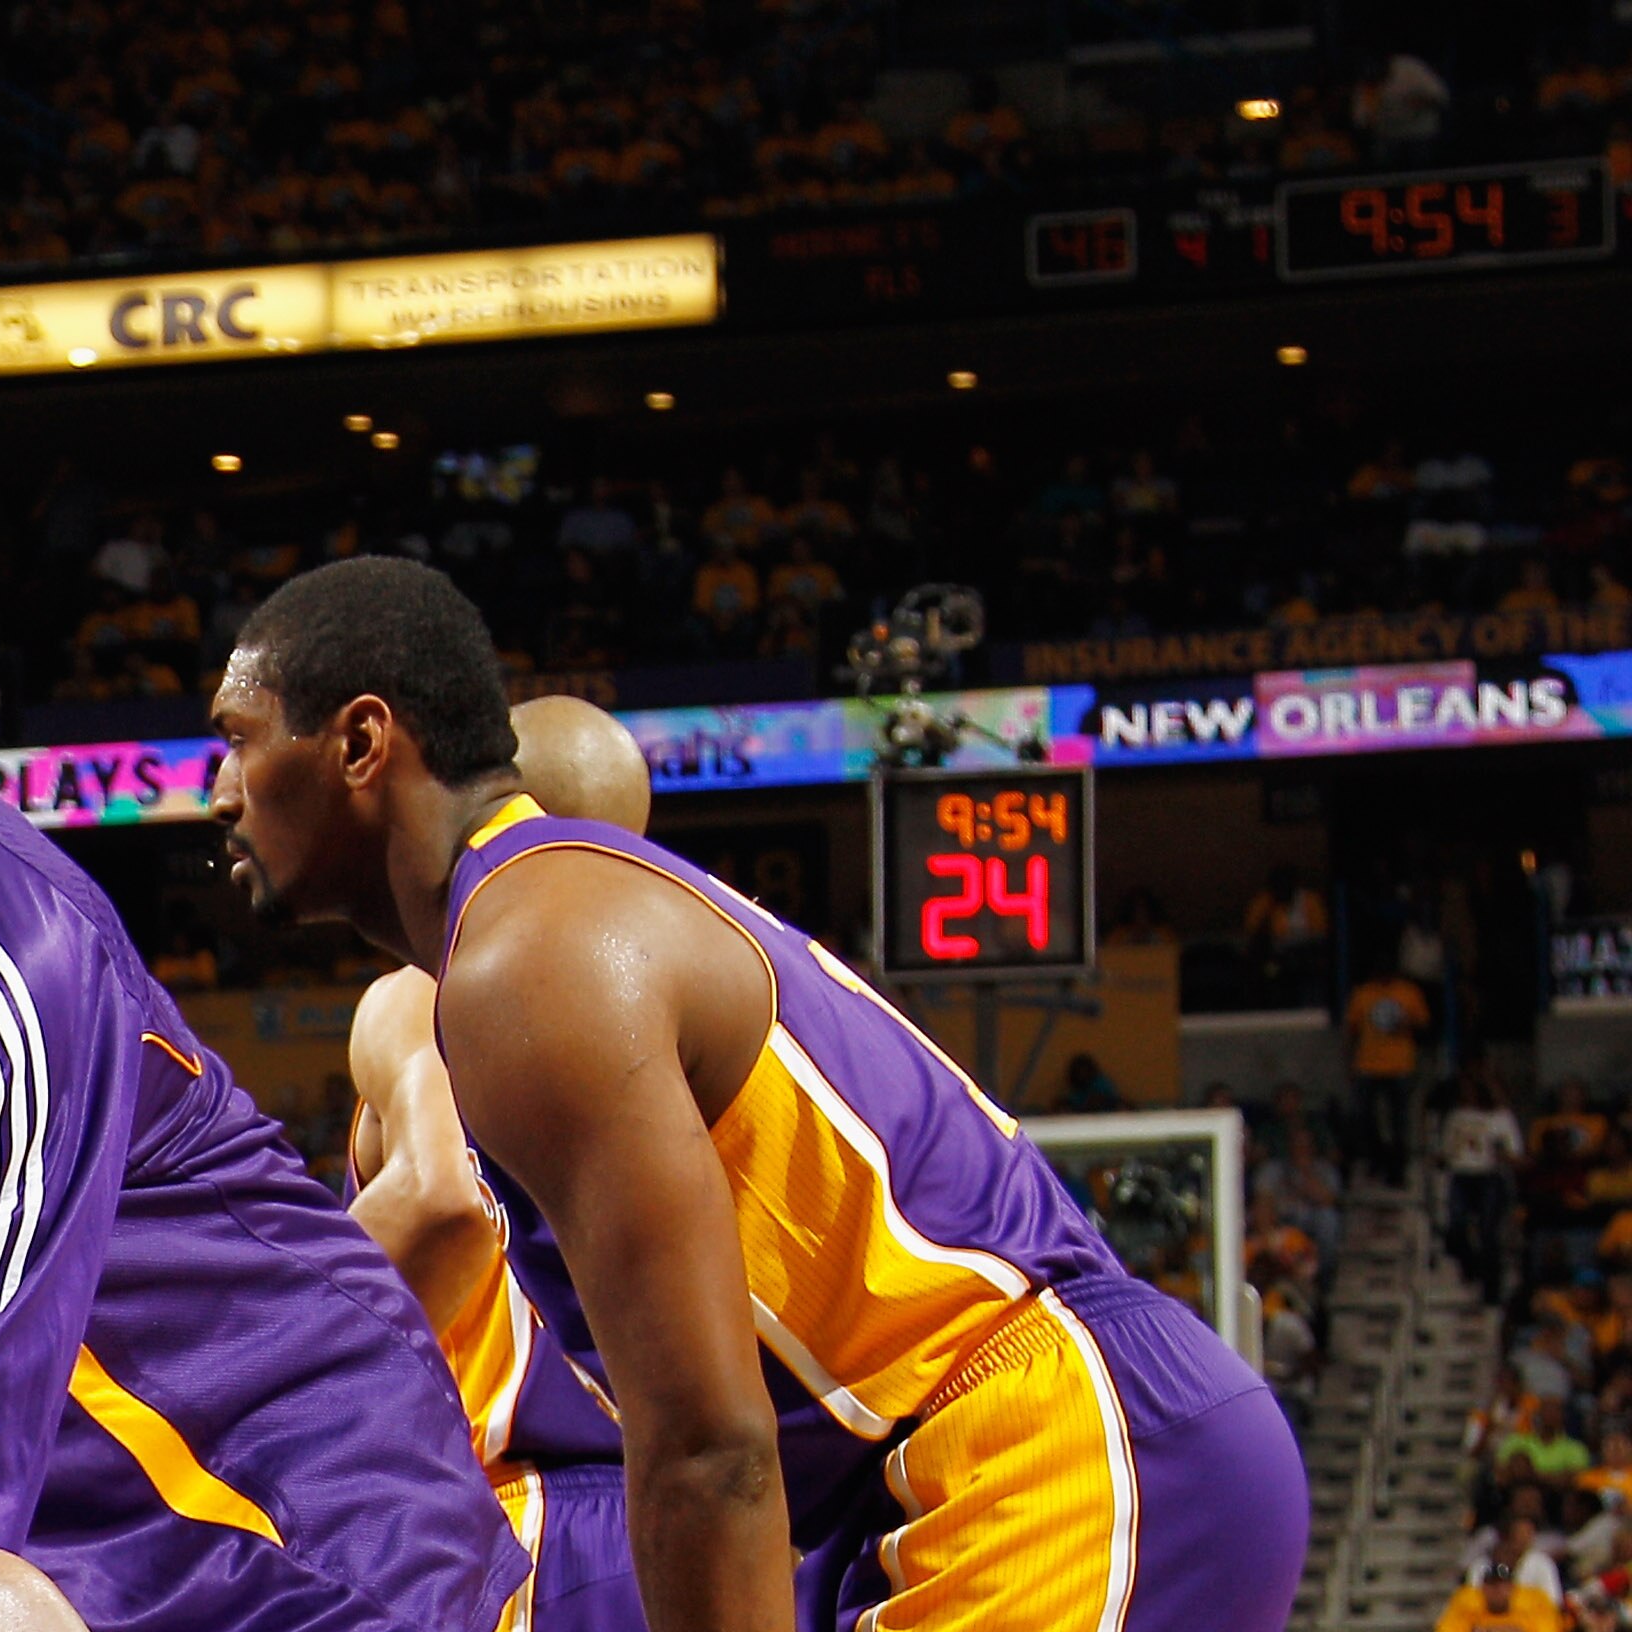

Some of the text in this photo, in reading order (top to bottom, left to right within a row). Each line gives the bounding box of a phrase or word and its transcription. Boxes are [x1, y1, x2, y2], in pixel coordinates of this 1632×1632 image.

[1340, 182, 1505, 259] 9:54
[348, 255, 705, 301] TRANSPORTATION
[110, 286, 261, 349] CRC
[1023, 629, 1272, 678] INSURANCE
[1284, 616, 1468, 664] AGENCY
[1472, 613, 1534, 659] OF
[1101, 677, 1568, 749] NEW ORLEANS
[937, 790, 1069, 851] 9:54
[921, 852, 1051, 960] 24
